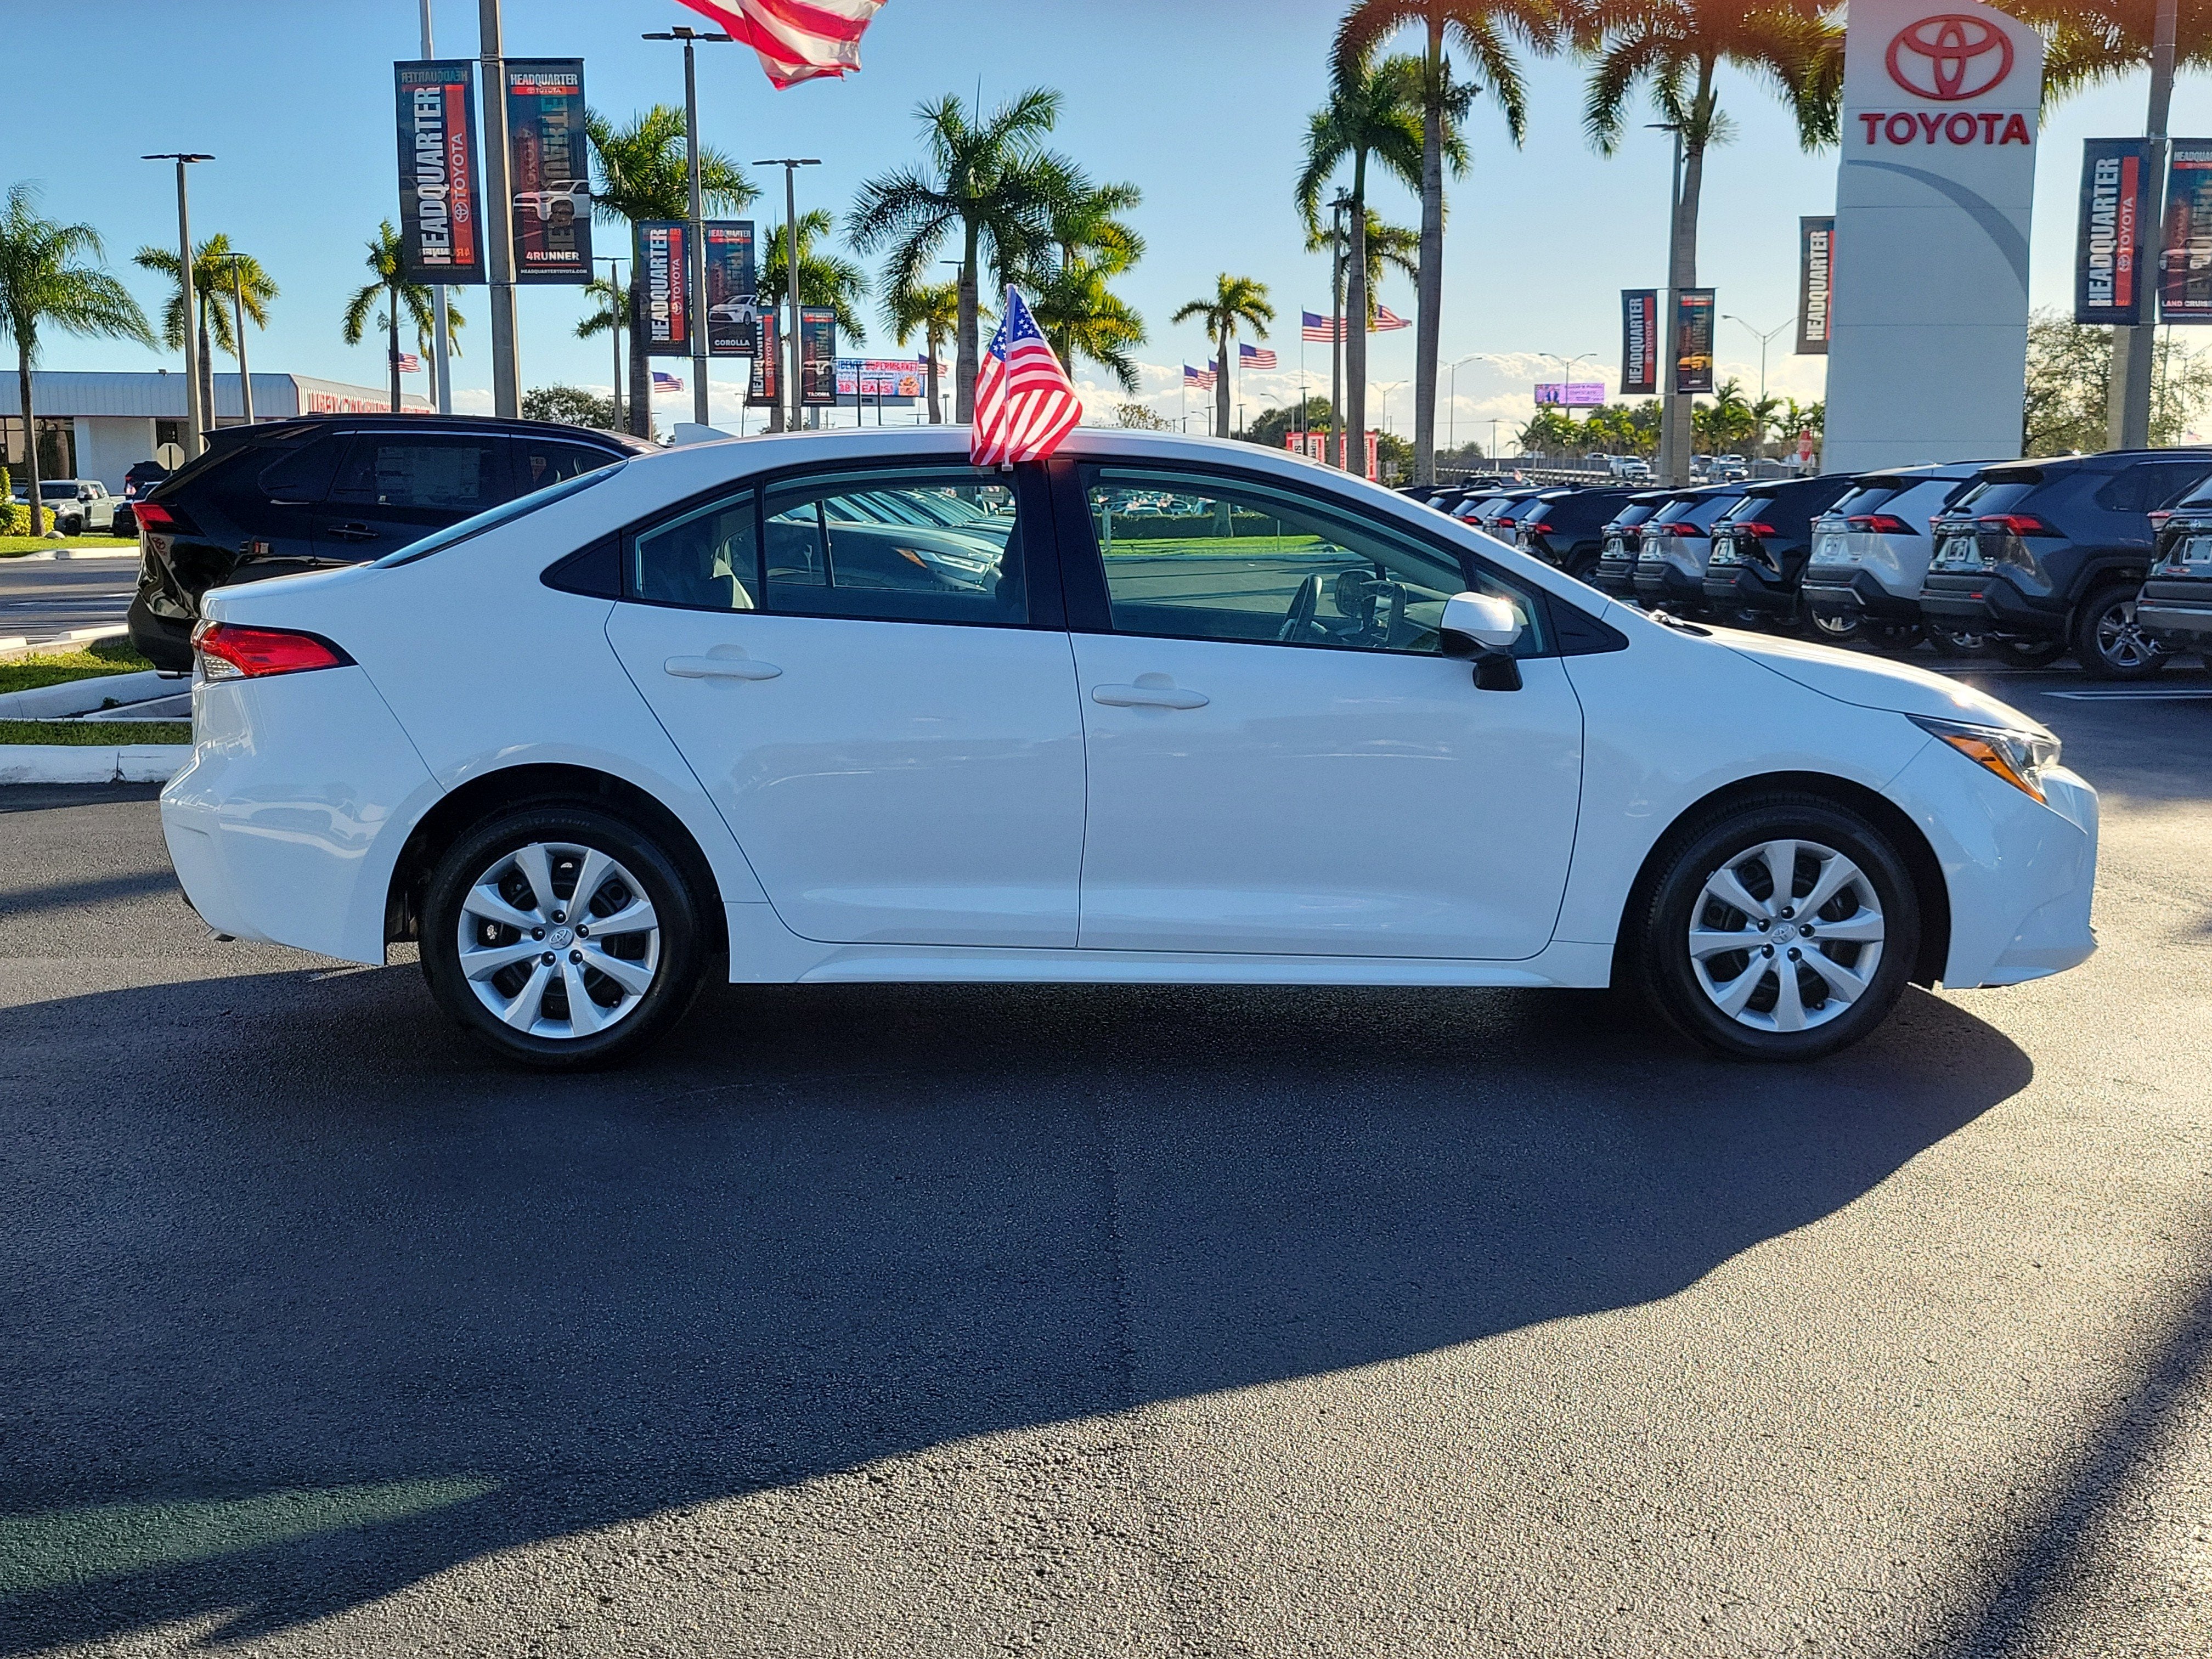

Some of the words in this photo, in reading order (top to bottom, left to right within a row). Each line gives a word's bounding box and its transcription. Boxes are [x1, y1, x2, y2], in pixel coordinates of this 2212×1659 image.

[510, 74, 578, 87] HEADQUARTER
[1859, 112, 2030, 145] TOYOTA
[414, 86, 452, 264] HEADQUARTER
[451, 133, 468, 201] TOYOTA
[708, 229, 751, 238] HEADQUARTER
[2089, 159, 2120, 306] HEADQUARTER
[2119, 196, 2134, 253] TOYOTA
[526, 251, 580, 261] 4RUNNER
[672, 258, 681, 301] TOYOTA
[650, 229, 670, 341] HEADQUARTER
[1806, 231, 1829, 341] HEADQUARTER
[1628, 298, 1645, 384] HEADQUARTER
[838, 384, 851, 393] 28
